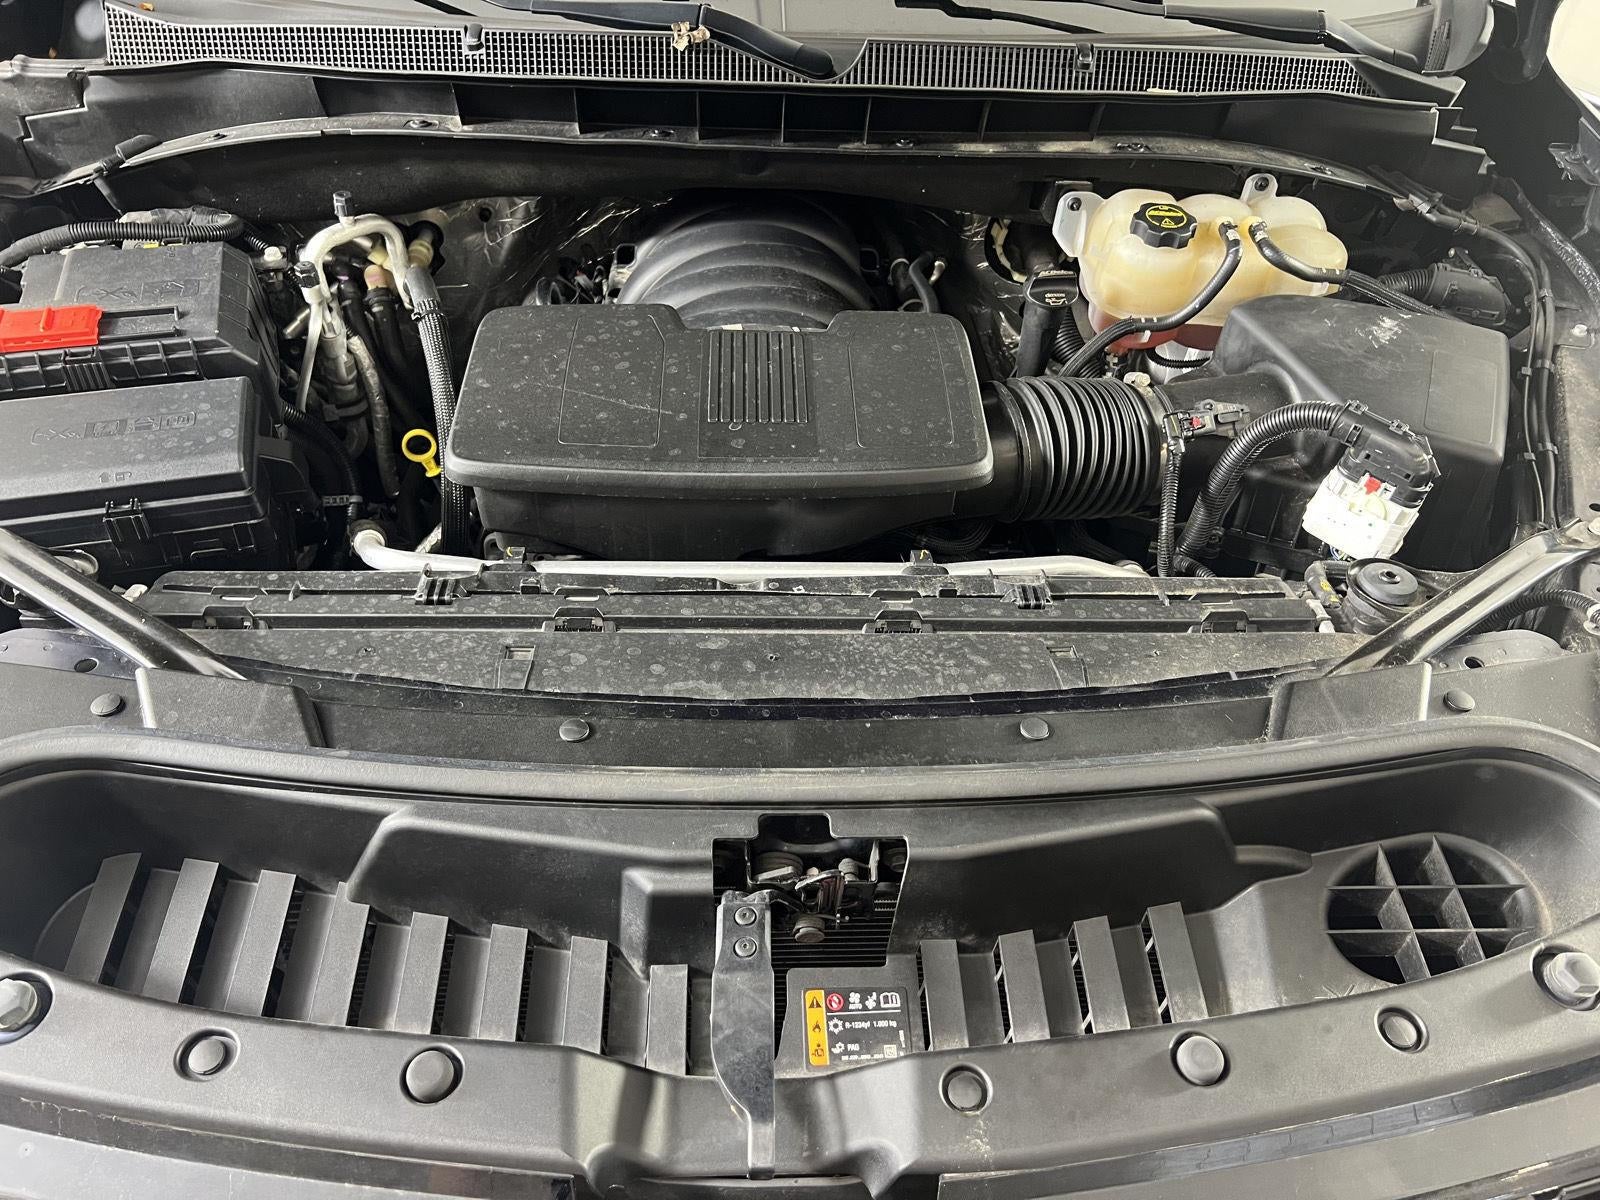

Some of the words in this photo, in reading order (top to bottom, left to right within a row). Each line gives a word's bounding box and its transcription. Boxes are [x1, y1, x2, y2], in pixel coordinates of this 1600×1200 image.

[1038, 269, 1073, 277] ACDelco
[845, 1020, 870, 1029] R-1234yf
[873, 1020, 888, 1028] 1.000
[889, 1020, 897, 1028] kg
[847, 1043, 860, 1051] PAG
